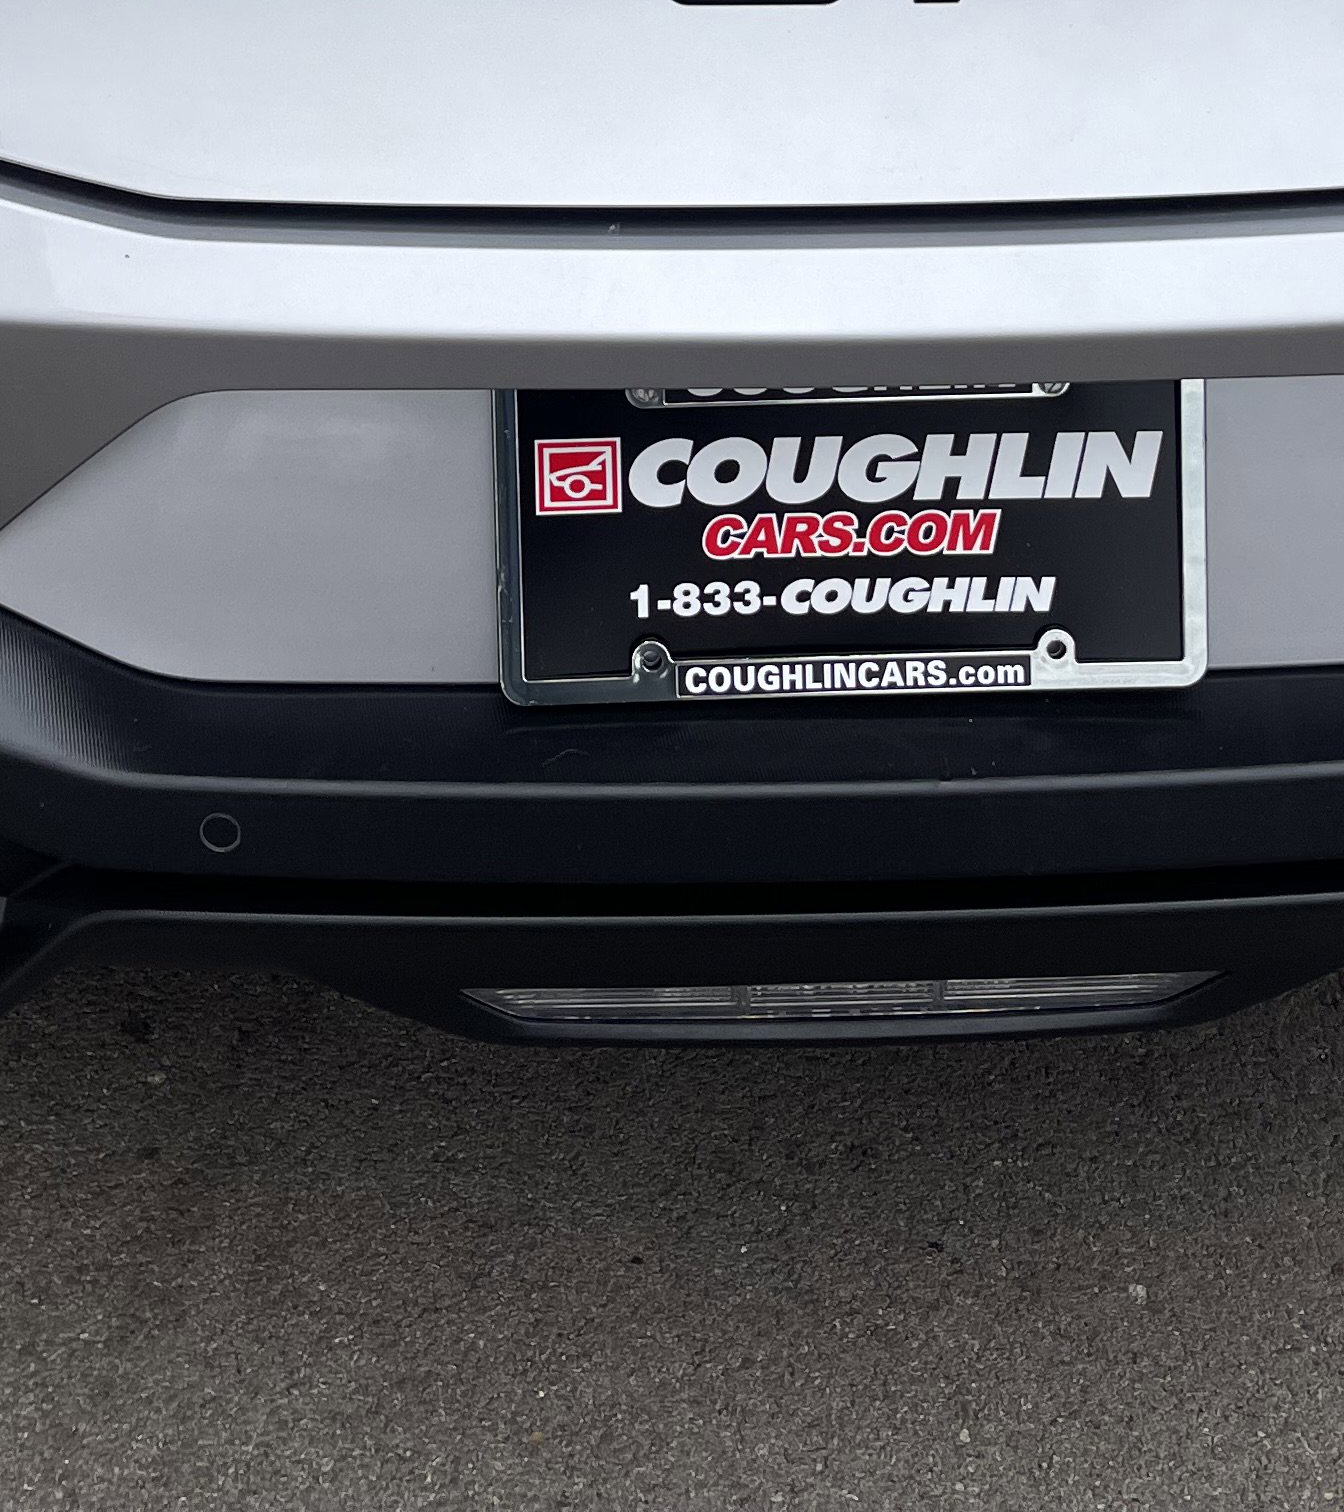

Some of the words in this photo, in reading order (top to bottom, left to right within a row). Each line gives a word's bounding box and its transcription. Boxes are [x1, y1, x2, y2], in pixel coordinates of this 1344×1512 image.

[627, 430, 1164, 508] COUGHLIN
[701, 508, 1003, 561] CARS.COM
[629, 575, 1057, 619] 1-833-COUGHLIN
[684, 660, 1027, 695] COUGHLINCARS.com
